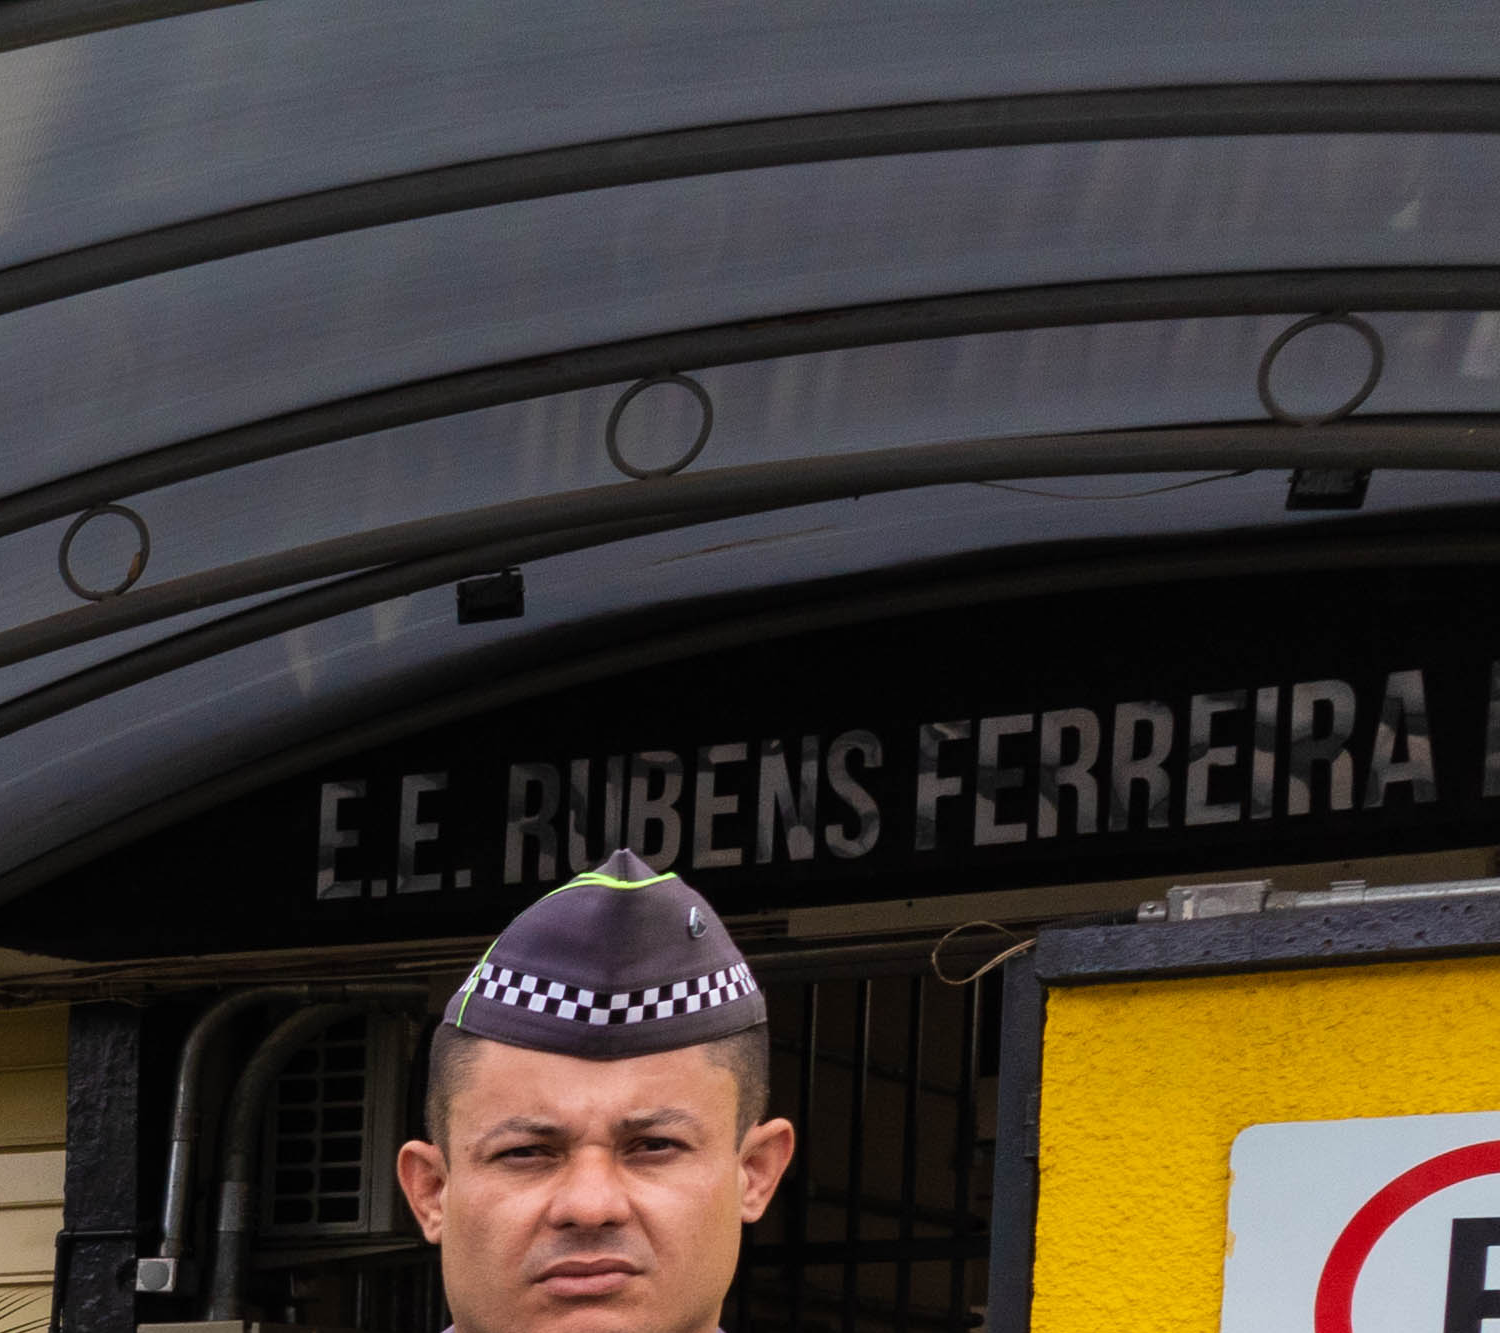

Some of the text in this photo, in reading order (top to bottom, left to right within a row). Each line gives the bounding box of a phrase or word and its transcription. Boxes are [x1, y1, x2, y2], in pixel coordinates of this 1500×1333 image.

[316, 772, 473, 900] E.E.
[503, 729, 883, 886] RUBENS
[913, 668, 1438, 852] FERREIRA
